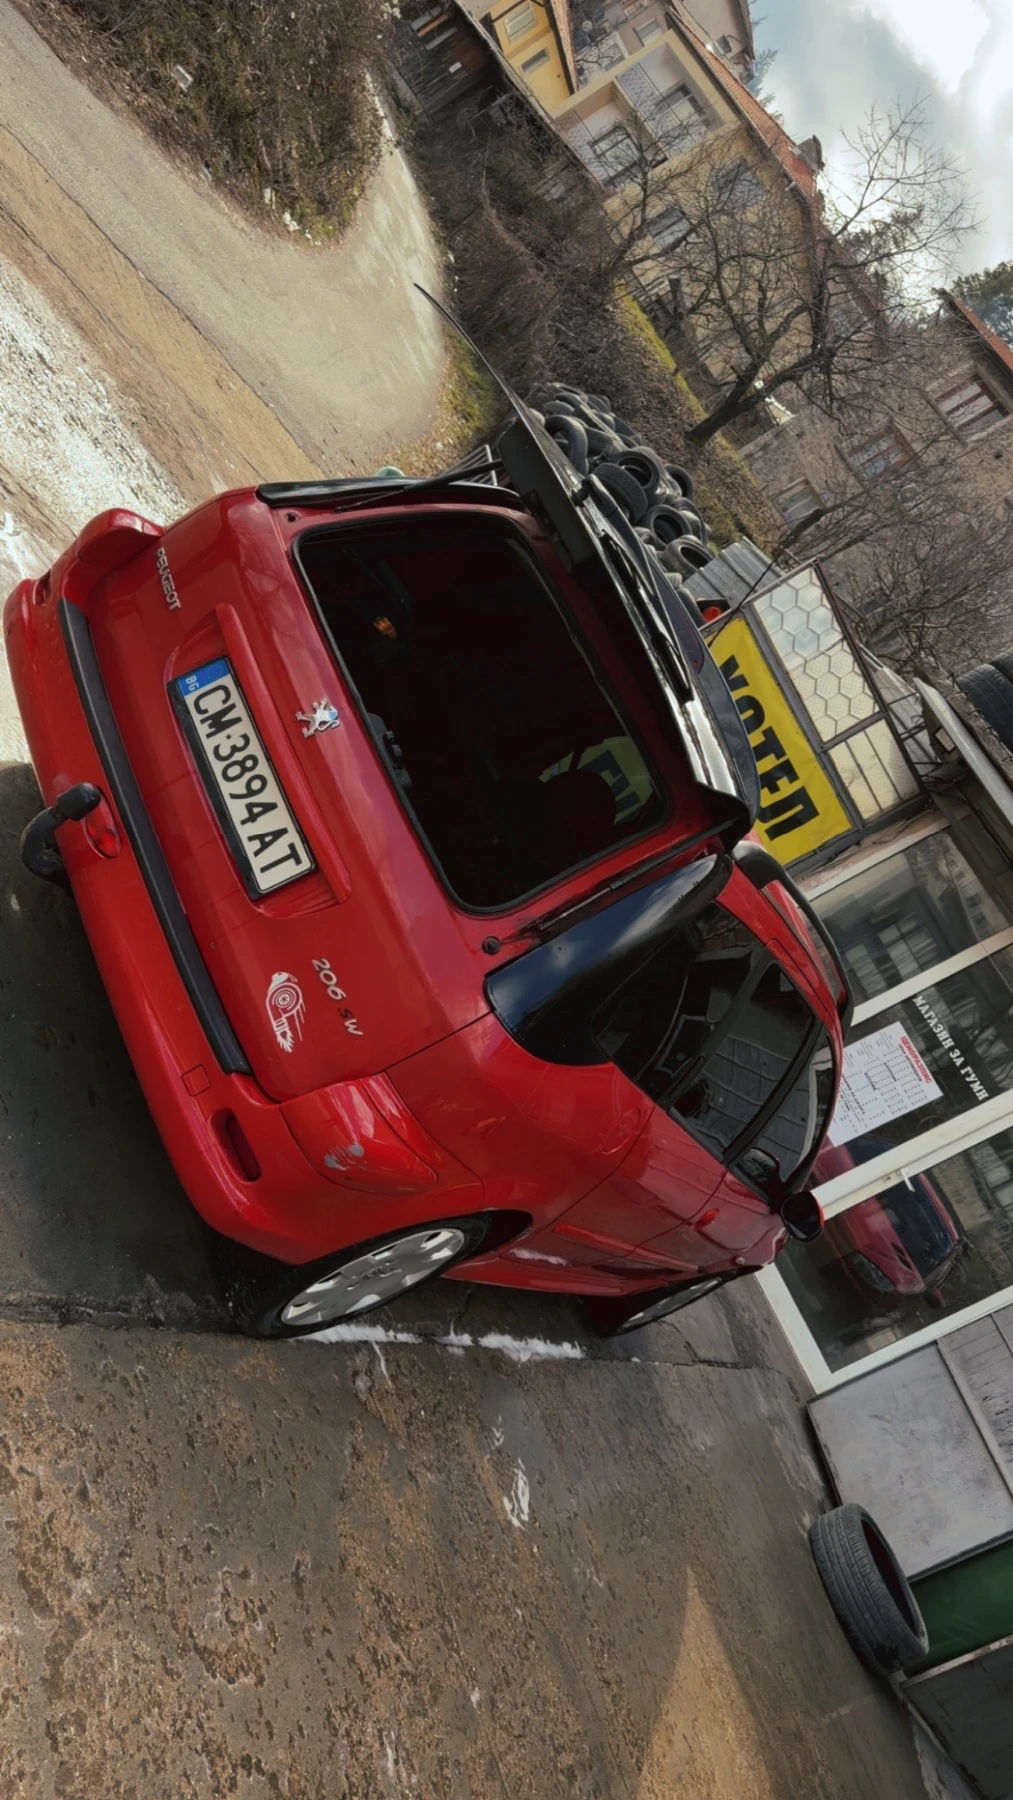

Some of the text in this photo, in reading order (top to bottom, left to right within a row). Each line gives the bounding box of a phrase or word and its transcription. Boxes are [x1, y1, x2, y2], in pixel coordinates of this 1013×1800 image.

[156, 546, 181, 610] PEUGEOT
[185, 675, 200, 692] BG
[311, 958, 364, 1035] 206 SW
[900, 1035, 933, 1084] ЦЕНОРАЗПИС
[913, 995, 990, 1101] МАГАЗИН ЗА ГУМИ
